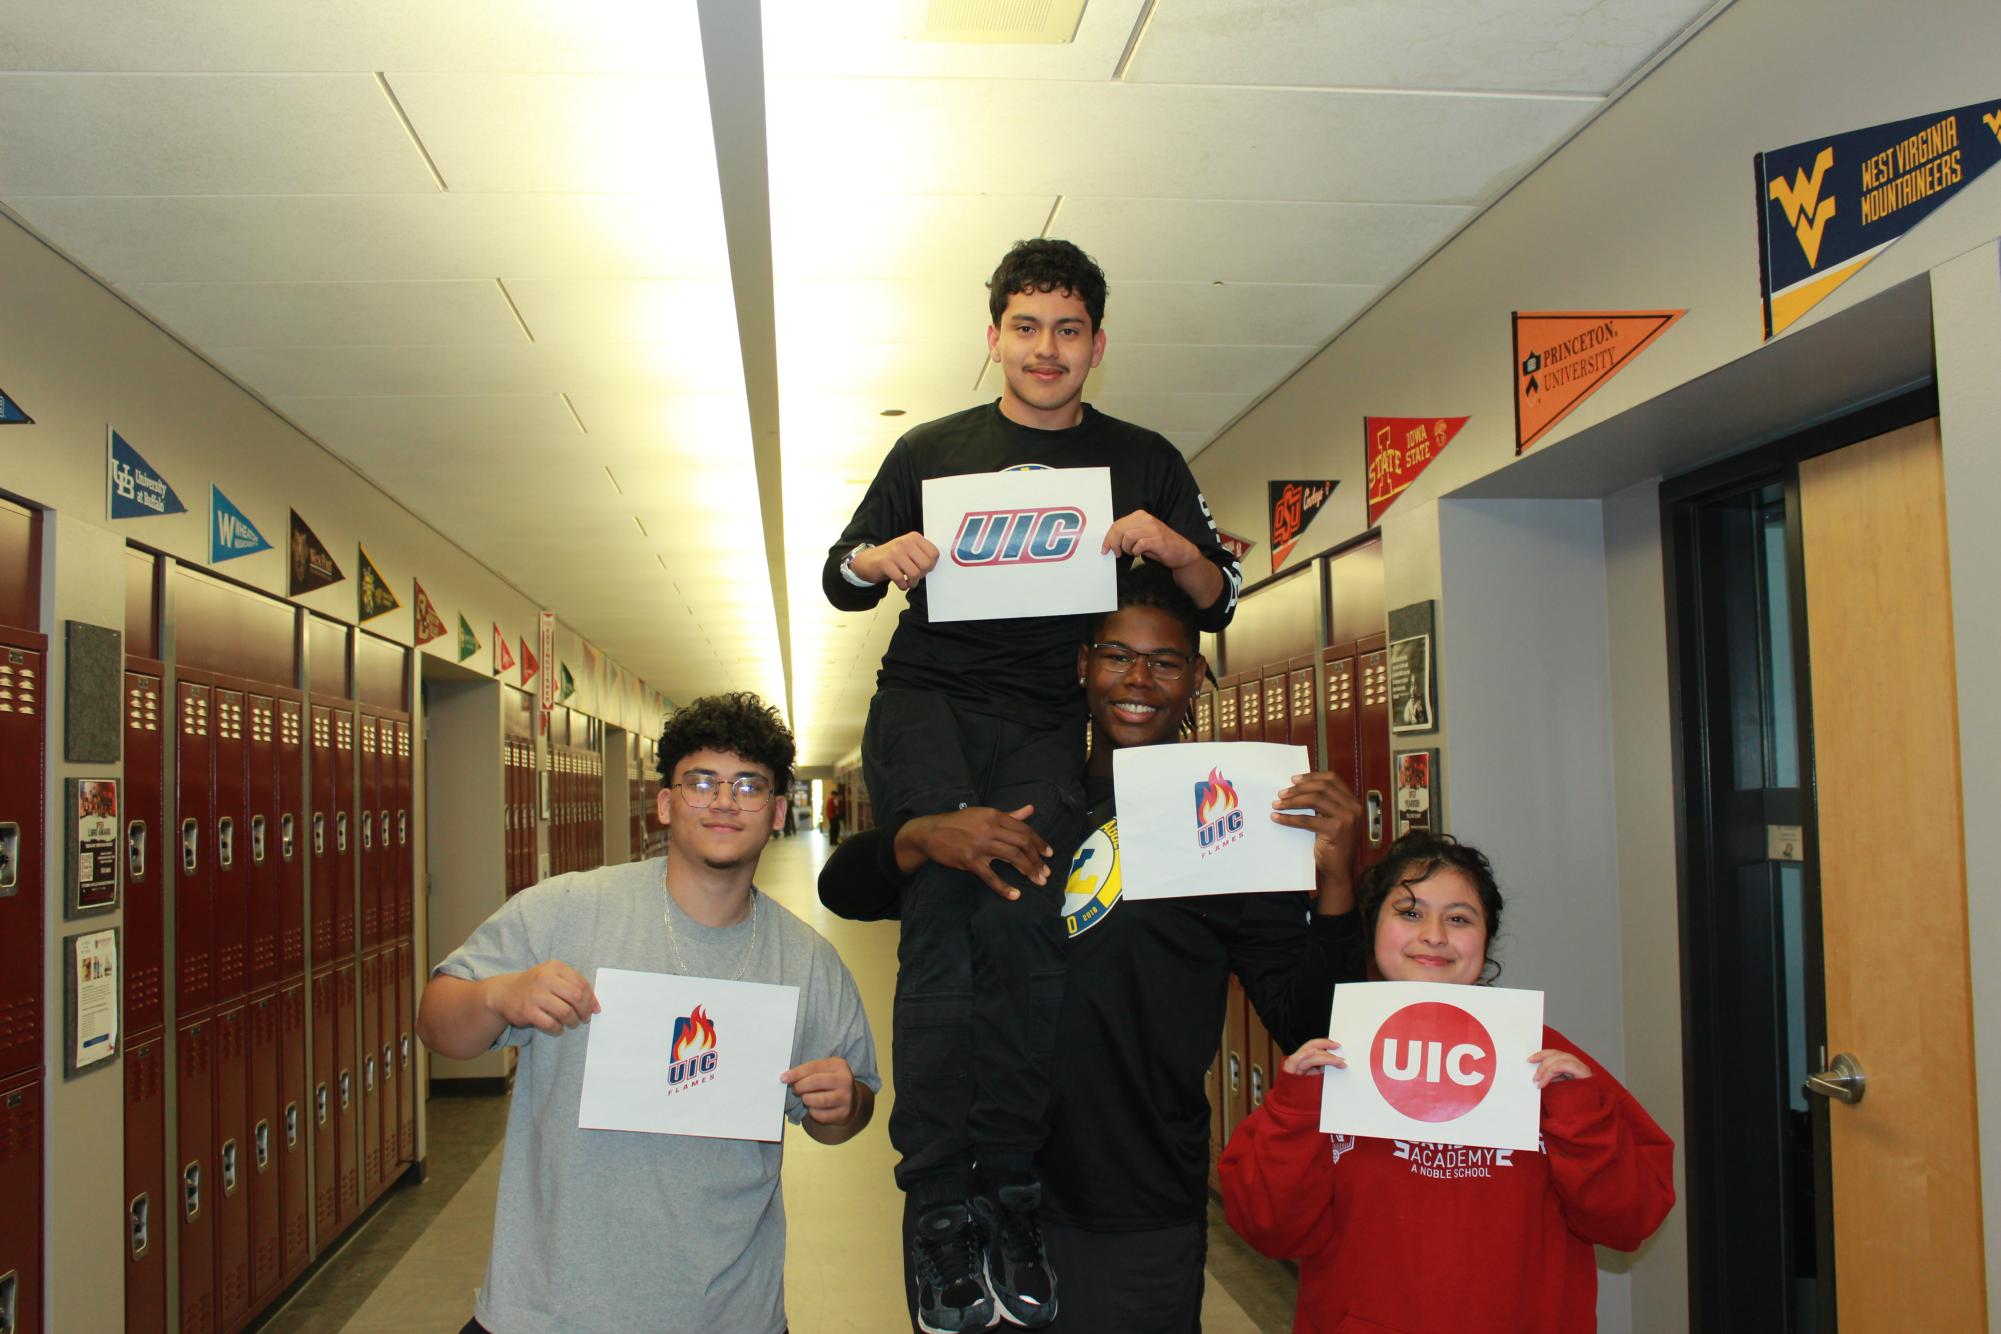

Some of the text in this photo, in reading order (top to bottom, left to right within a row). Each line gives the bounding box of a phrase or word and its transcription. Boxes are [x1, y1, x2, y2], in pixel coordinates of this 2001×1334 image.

[1862, 148, 1894, 192] WEST
[1896, 115, 1959, 173] VIRGINIA
[1862, 150, 1963, 226] MOUNTAINEERS
[1543, 346, 1616, 392] UNIVERSITY
[1406, 424, 1428, 449] IOWA
[1406, 441, 1431, 468] STATE
[135, 468, 167, 499] University
[1369, 448, 1402, 489] STATE
[137, 490, 165, 513] at Buffalo
[217, 510, 235, 548] W
[954, 509, 1084, 564] UIC
[1198, 809, 1243, 849] UIC
[1201, 831, 1244, 859] FLAMES
[668, 1050, 719, 1086] UIC
[1382, 1038, 1486, 1086] UIC
[668, 1074, 715, 1096] FLAMES
[1410, 1147, 1495, 1168] ACADEMY
[1410, 1164, 1492, 1179] A NOBLE SCHOOL
